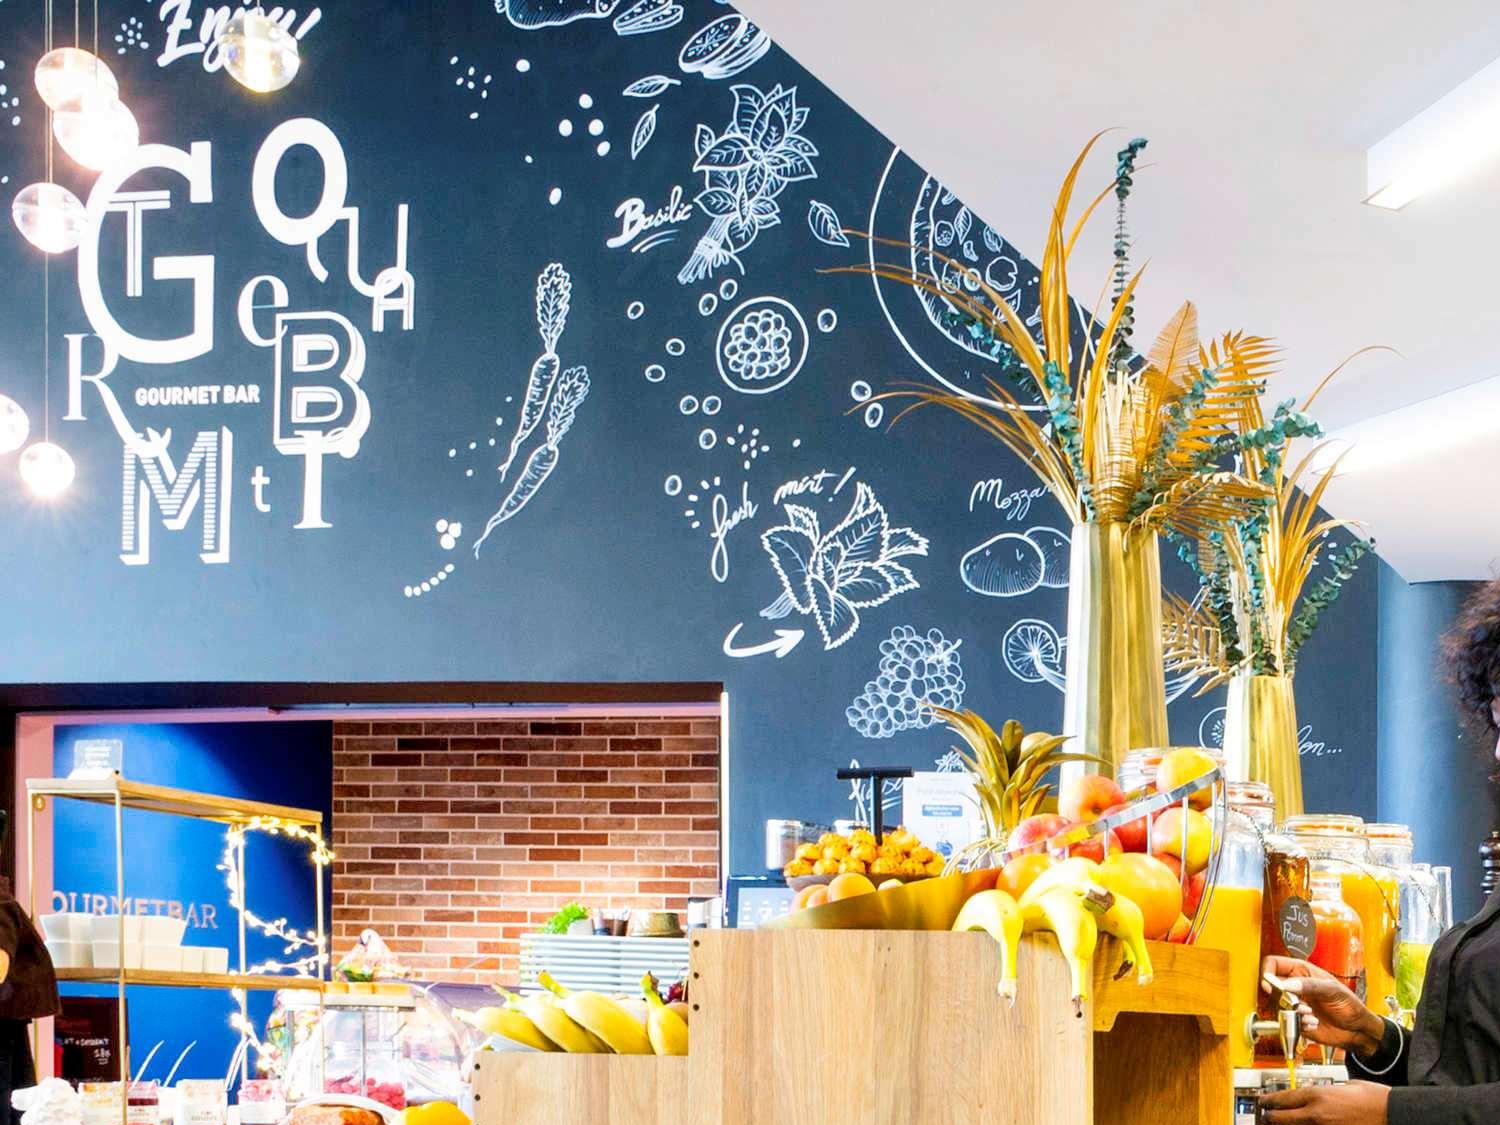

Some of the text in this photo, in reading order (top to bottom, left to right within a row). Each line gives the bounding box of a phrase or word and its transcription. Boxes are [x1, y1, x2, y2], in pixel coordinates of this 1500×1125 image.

[606, 185, 693, 248] Basilic
[135, 384, 261, 407] GOURMET BAR
[711, 480, 760, 584] fresh
[1286, 904, 1309, 928] Jus
